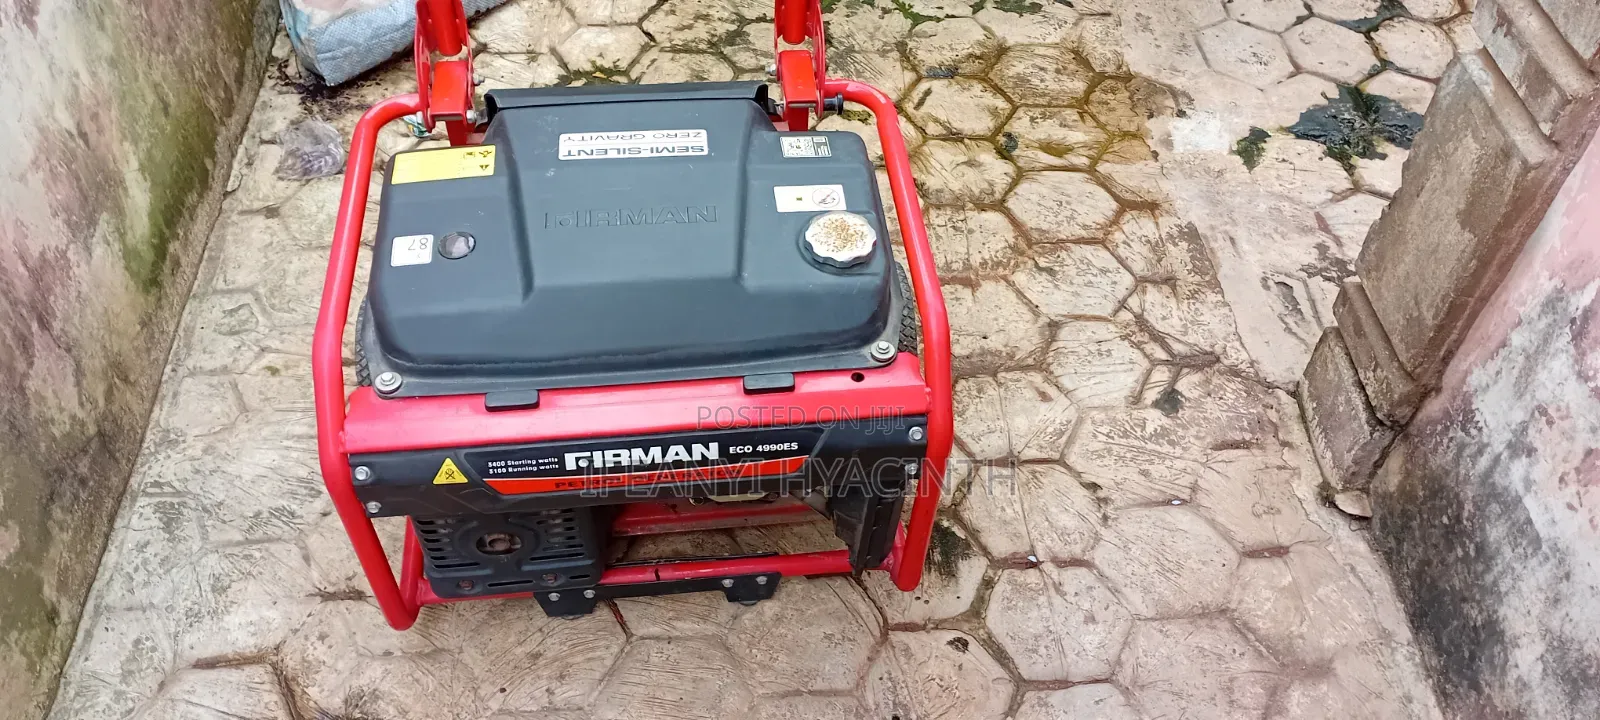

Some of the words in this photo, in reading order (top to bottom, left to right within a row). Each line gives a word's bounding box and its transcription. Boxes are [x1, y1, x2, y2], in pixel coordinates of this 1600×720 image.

[563, 133, 646, 142] GRAVITY
[652, 131, 703, 139] ZERO
[562, 145, 705, 157] SEMI-SILENT
[407, 237, 429, 251] 87
[729, 446, 753, 454] ECO
[756, 442, 799, 452] 4990ES
[564, 442, 720, 471] FIRMAN
